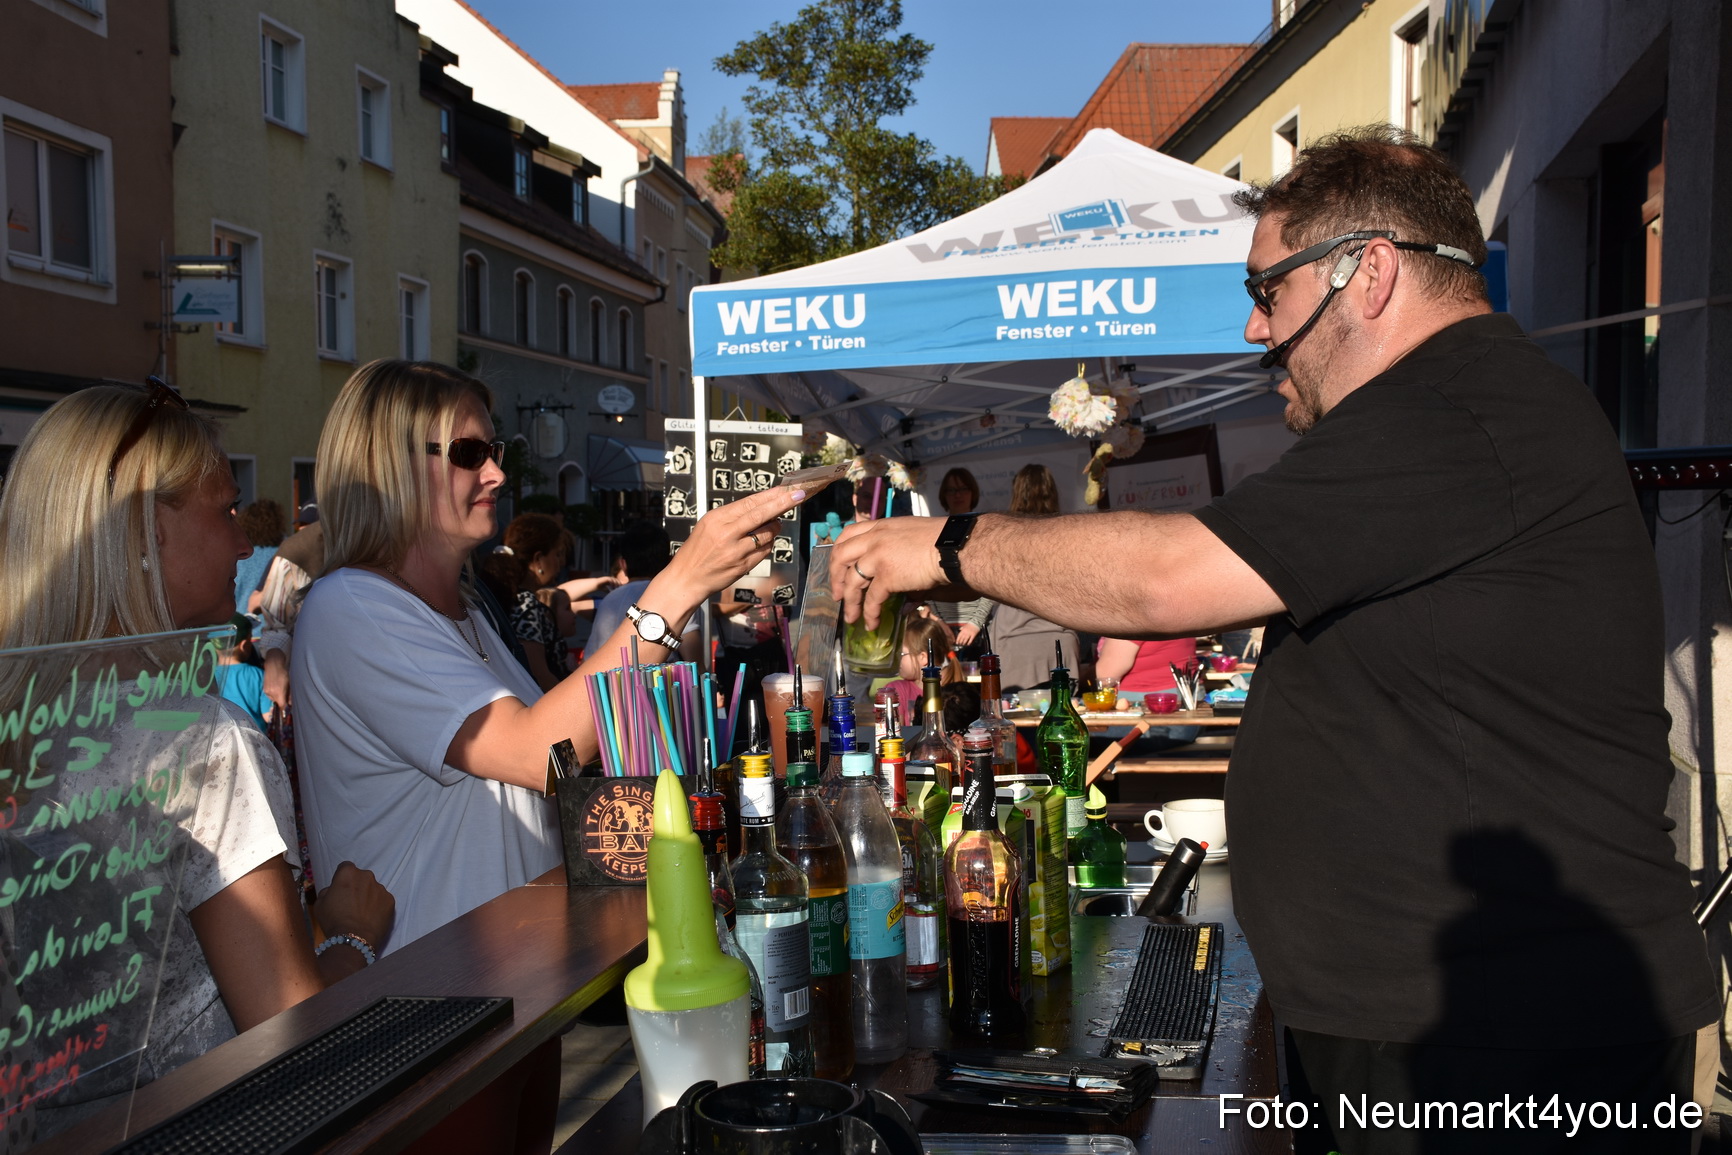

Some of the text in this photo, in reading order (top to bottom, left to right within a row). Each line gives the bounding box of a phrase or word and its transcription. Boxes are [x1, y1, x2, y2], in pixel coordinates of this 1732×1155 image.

[905, 193, 1245, 263] WEKU
[1063, 207, 1104, 220] WEKU
[943, 228, 1220, 258] FENSTER TÜREN
[997, 277, 1157, 320] WEKU
[717, 292, 867, 336] WEKU
[717, 334, 866, 356] Fenster Türen
[996, 319, 1157, 341] Fenster Türen
[586, 785, 655, 825] THE SING
[602, 853, 648, 874] KEEPE
